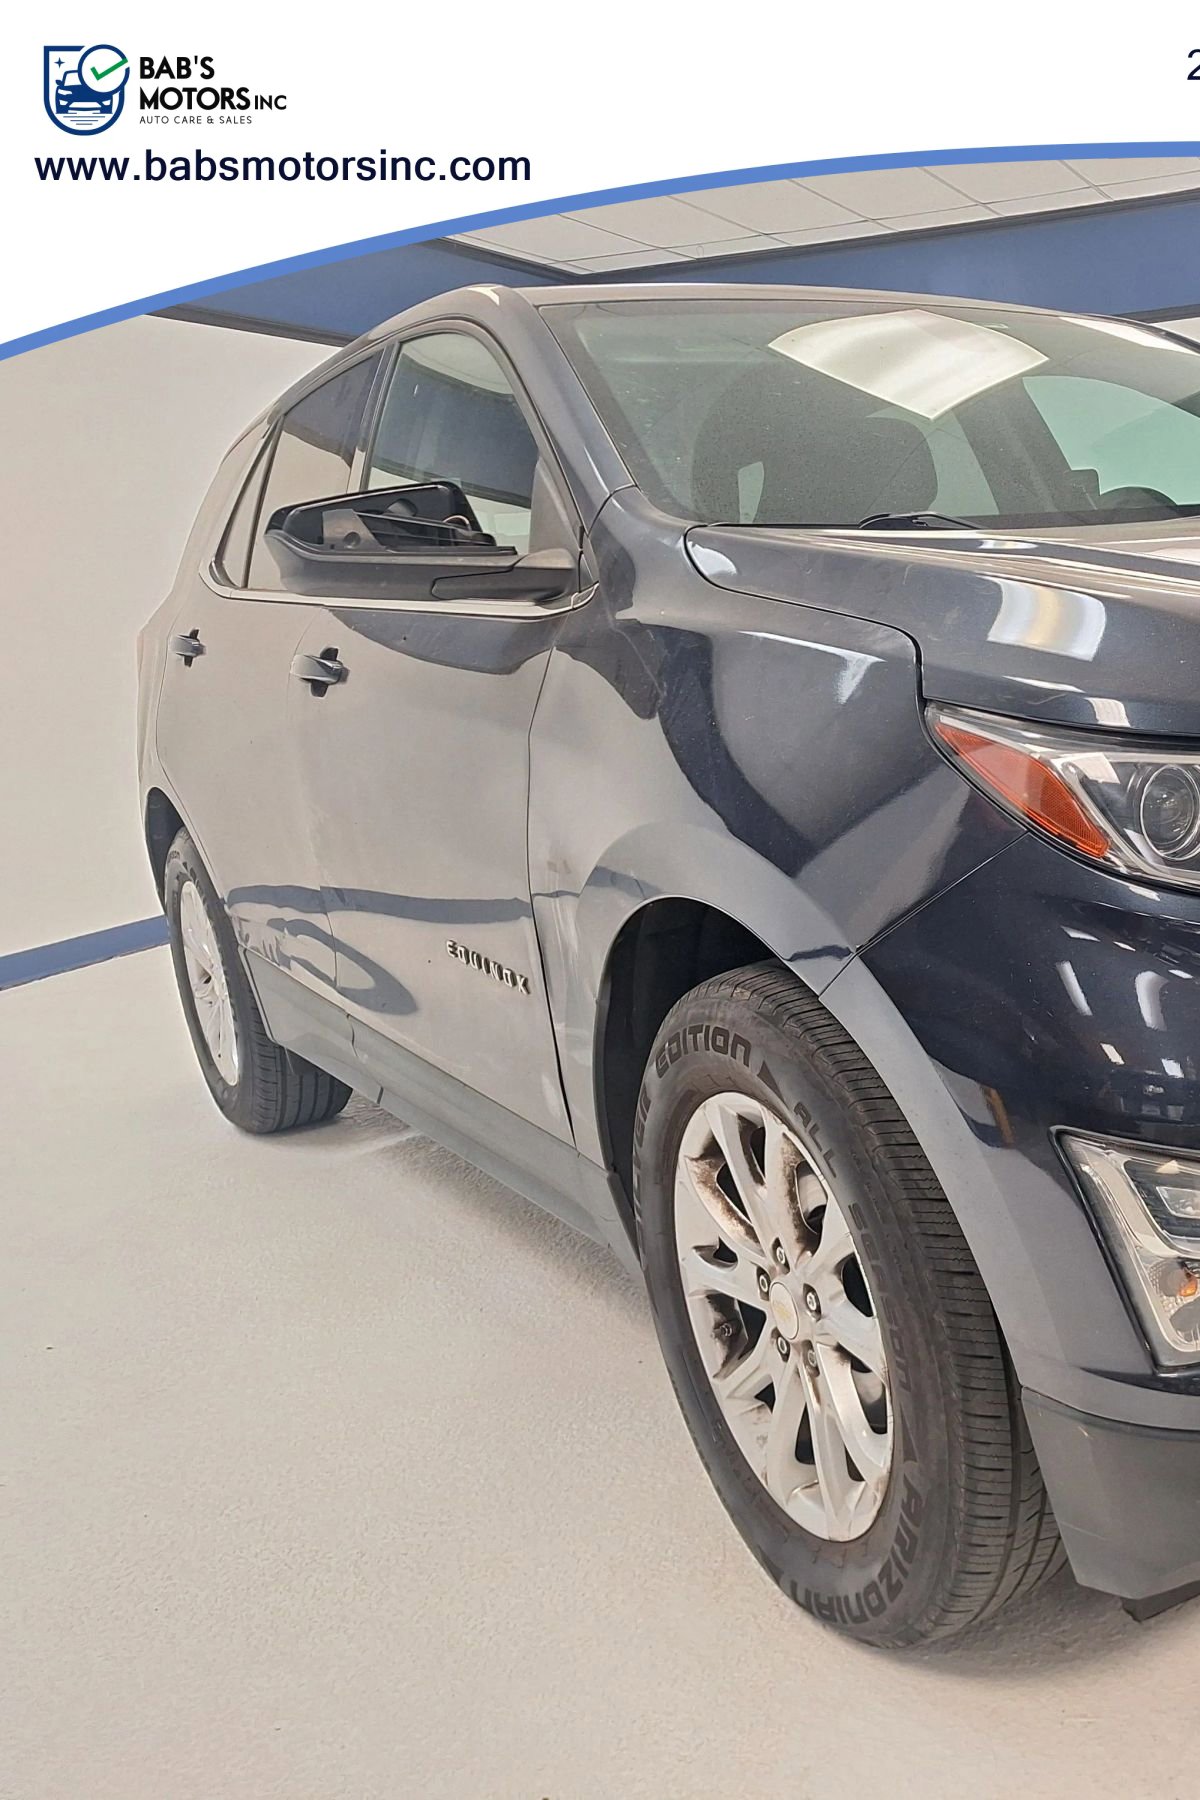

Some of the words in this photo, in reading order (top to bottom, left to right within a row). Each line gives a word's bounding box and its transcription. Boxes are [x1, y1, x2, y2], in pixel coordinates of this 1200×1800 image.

[446, 940, 531, 995] EQUINOX
[655, 1023, 752, 1079] EDITION
[793, 1101, 837, 1178] ALL
[789, 1473, 924, 1625] ARIZONIAN
